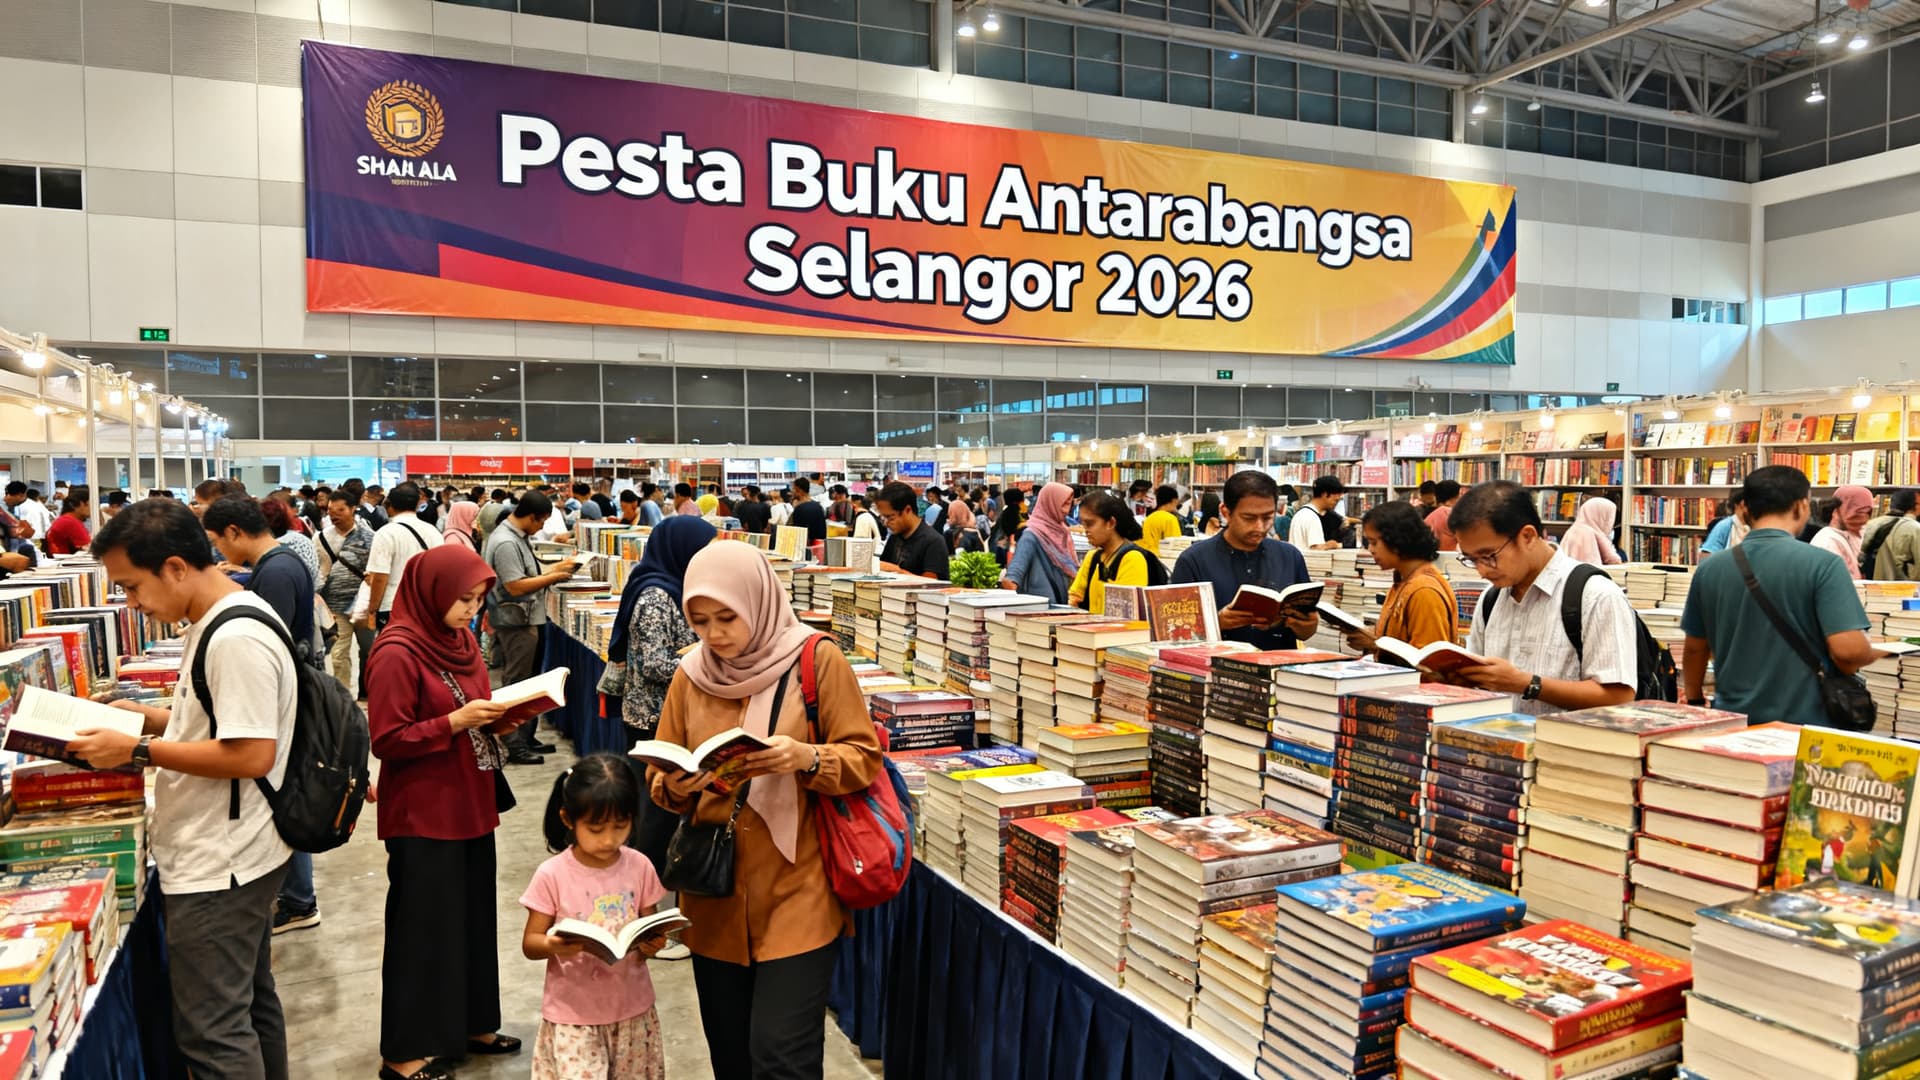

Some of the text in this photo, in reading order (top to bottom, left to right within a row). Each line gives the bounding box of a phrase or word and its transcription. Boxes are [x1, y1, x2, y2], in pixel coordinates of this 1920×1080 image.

[500, 113, 1411, 267] Pesta Buku Antarabangsa
[747, 225, 1251, 321] Selangor 2026
